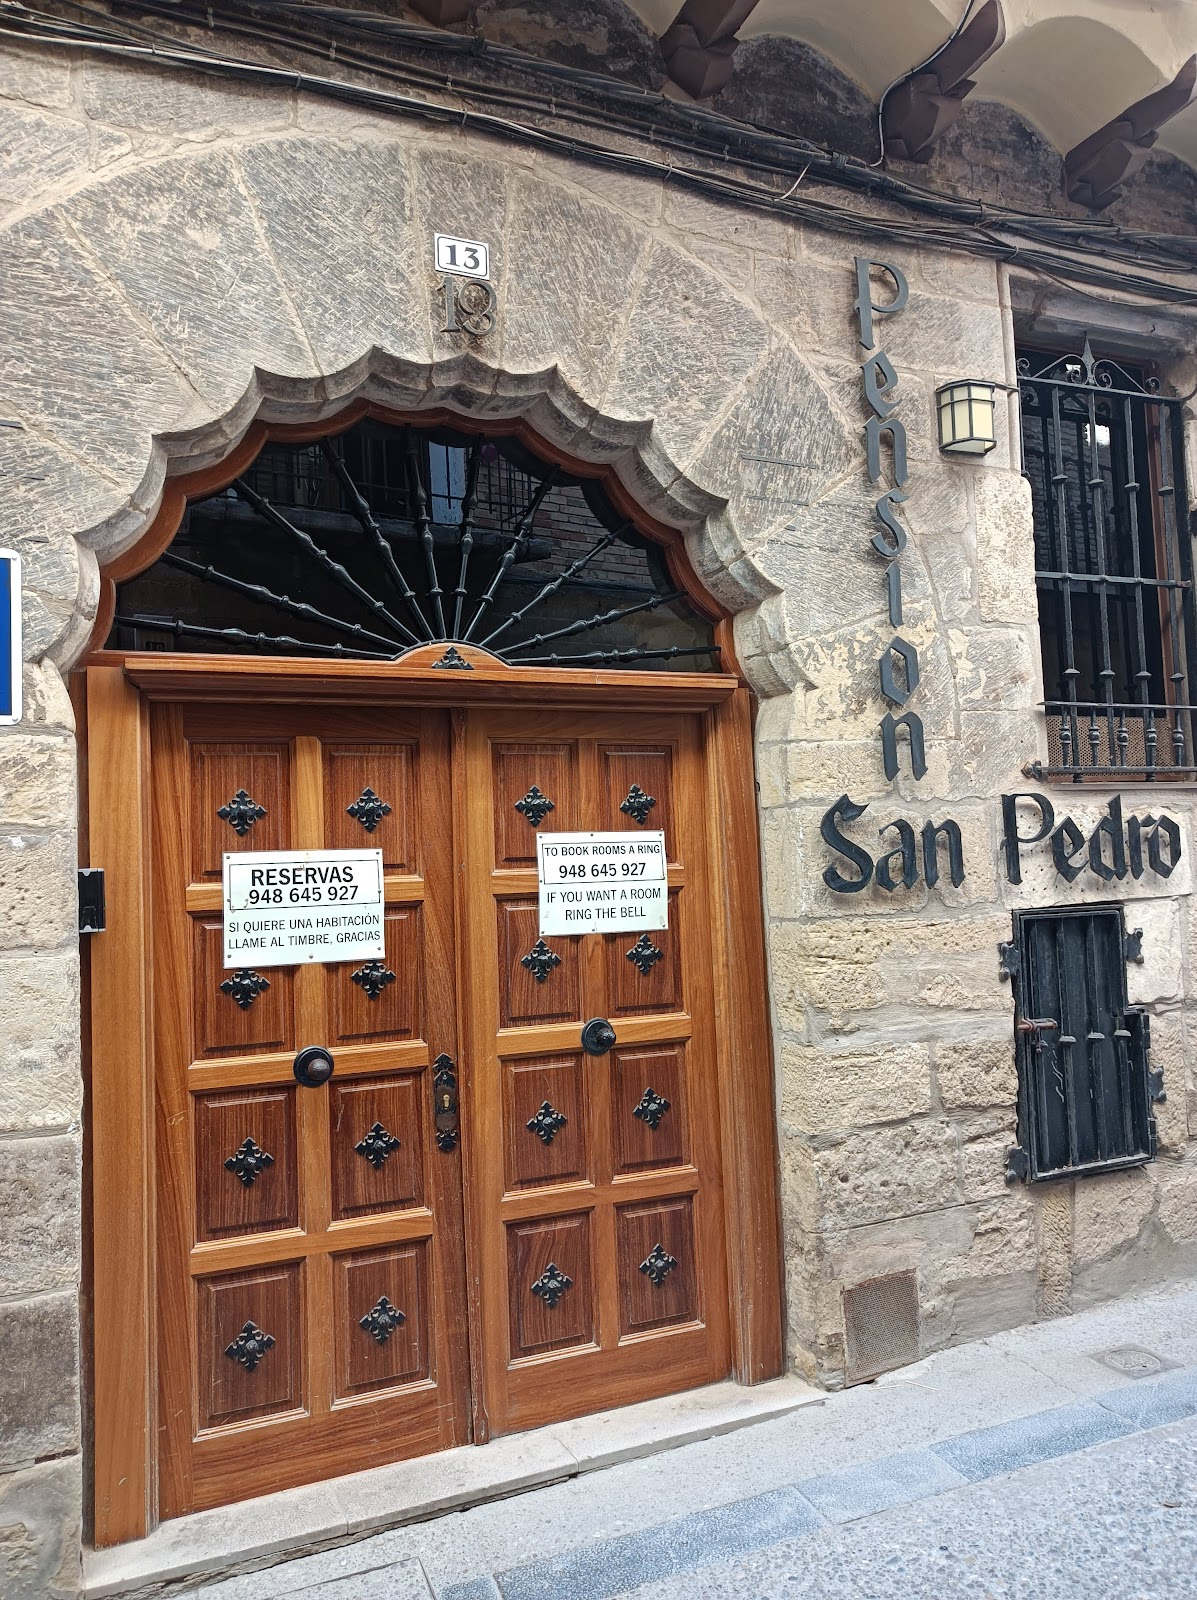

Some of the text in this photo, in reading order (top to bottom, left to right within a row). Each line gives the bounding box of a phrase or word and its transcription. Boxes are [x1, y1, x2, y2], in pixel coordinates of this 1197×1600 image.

[445, 244, 480, 270] 13
[853, 256, 928, 782] Pension
[544, 844, 660, 857] TO BOOK ROOMS A RING
[820, 792, 1182, 894] San Pedro
[251, 866, 354, 887] RESERVAS
[559, 862, 646, 879] 948 645 927
[249, 885, 359, 905] 948 645 927
[547, 888, 661, 903] IF YOU WANT A ROOM
[229, 912, 380, 934] SI QUIERE UNA HABITACIÓN
[565, 906, 646, 921] RING THE BELL
[228, 930, 381, 950] LLAME AL TIMBRE, GRACIAS
